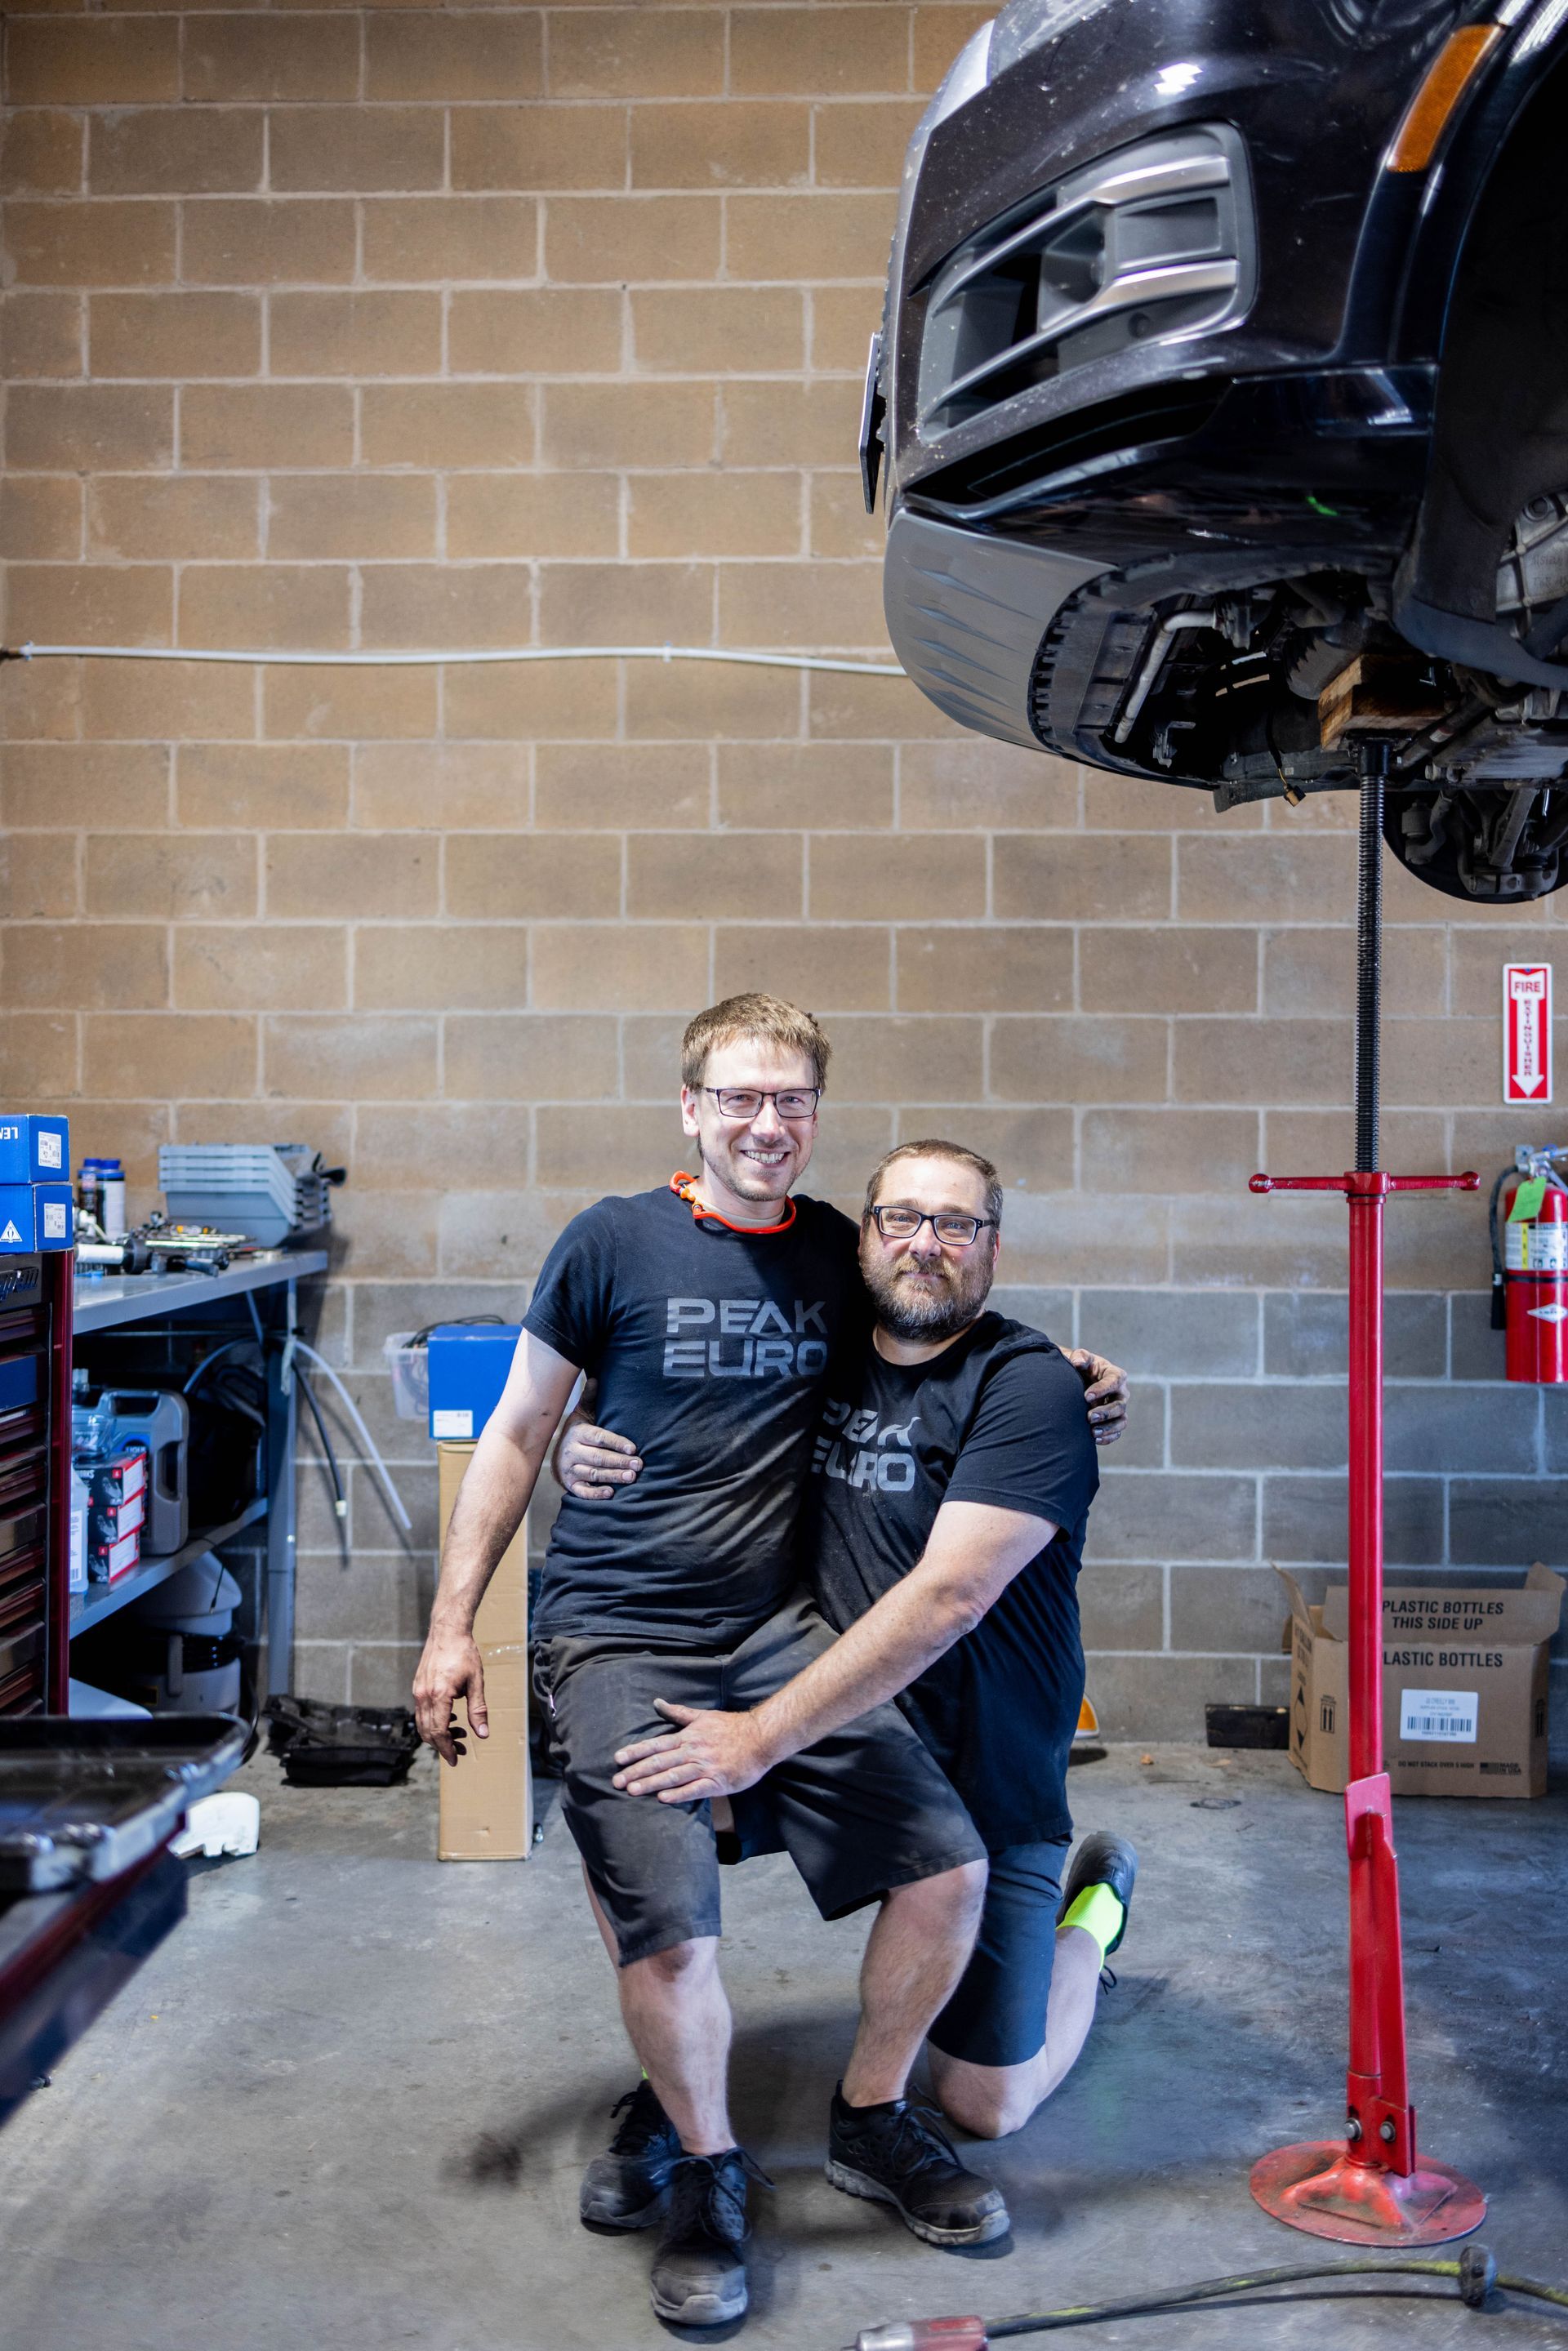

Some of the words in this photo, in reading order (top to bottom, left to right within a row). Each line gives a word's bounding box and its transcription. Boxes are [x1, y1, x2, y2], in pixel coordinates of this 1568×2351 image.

[1514, 982, 1541, 993] FIRE
[1524, 1000, 1532, 1076] EXTINGUISHER
[666, 1297, 828, 1334] PEAK
[662, 1339, 828, 1378] EURO
[1382, 1600, 1438, 1614] PLASTIC
[1443, 1601, 1503, 1614] BOTTLES
[1392, 1616, 1423, 1629] THIS
[1428, 1617, 1459, 1630] SIDE
[1463, 1618, 1483, 1631] UP
[1382, 1651, 1433, 1666] LASTIC
[1439, 1652, 1503, 1668] BOTTLES
